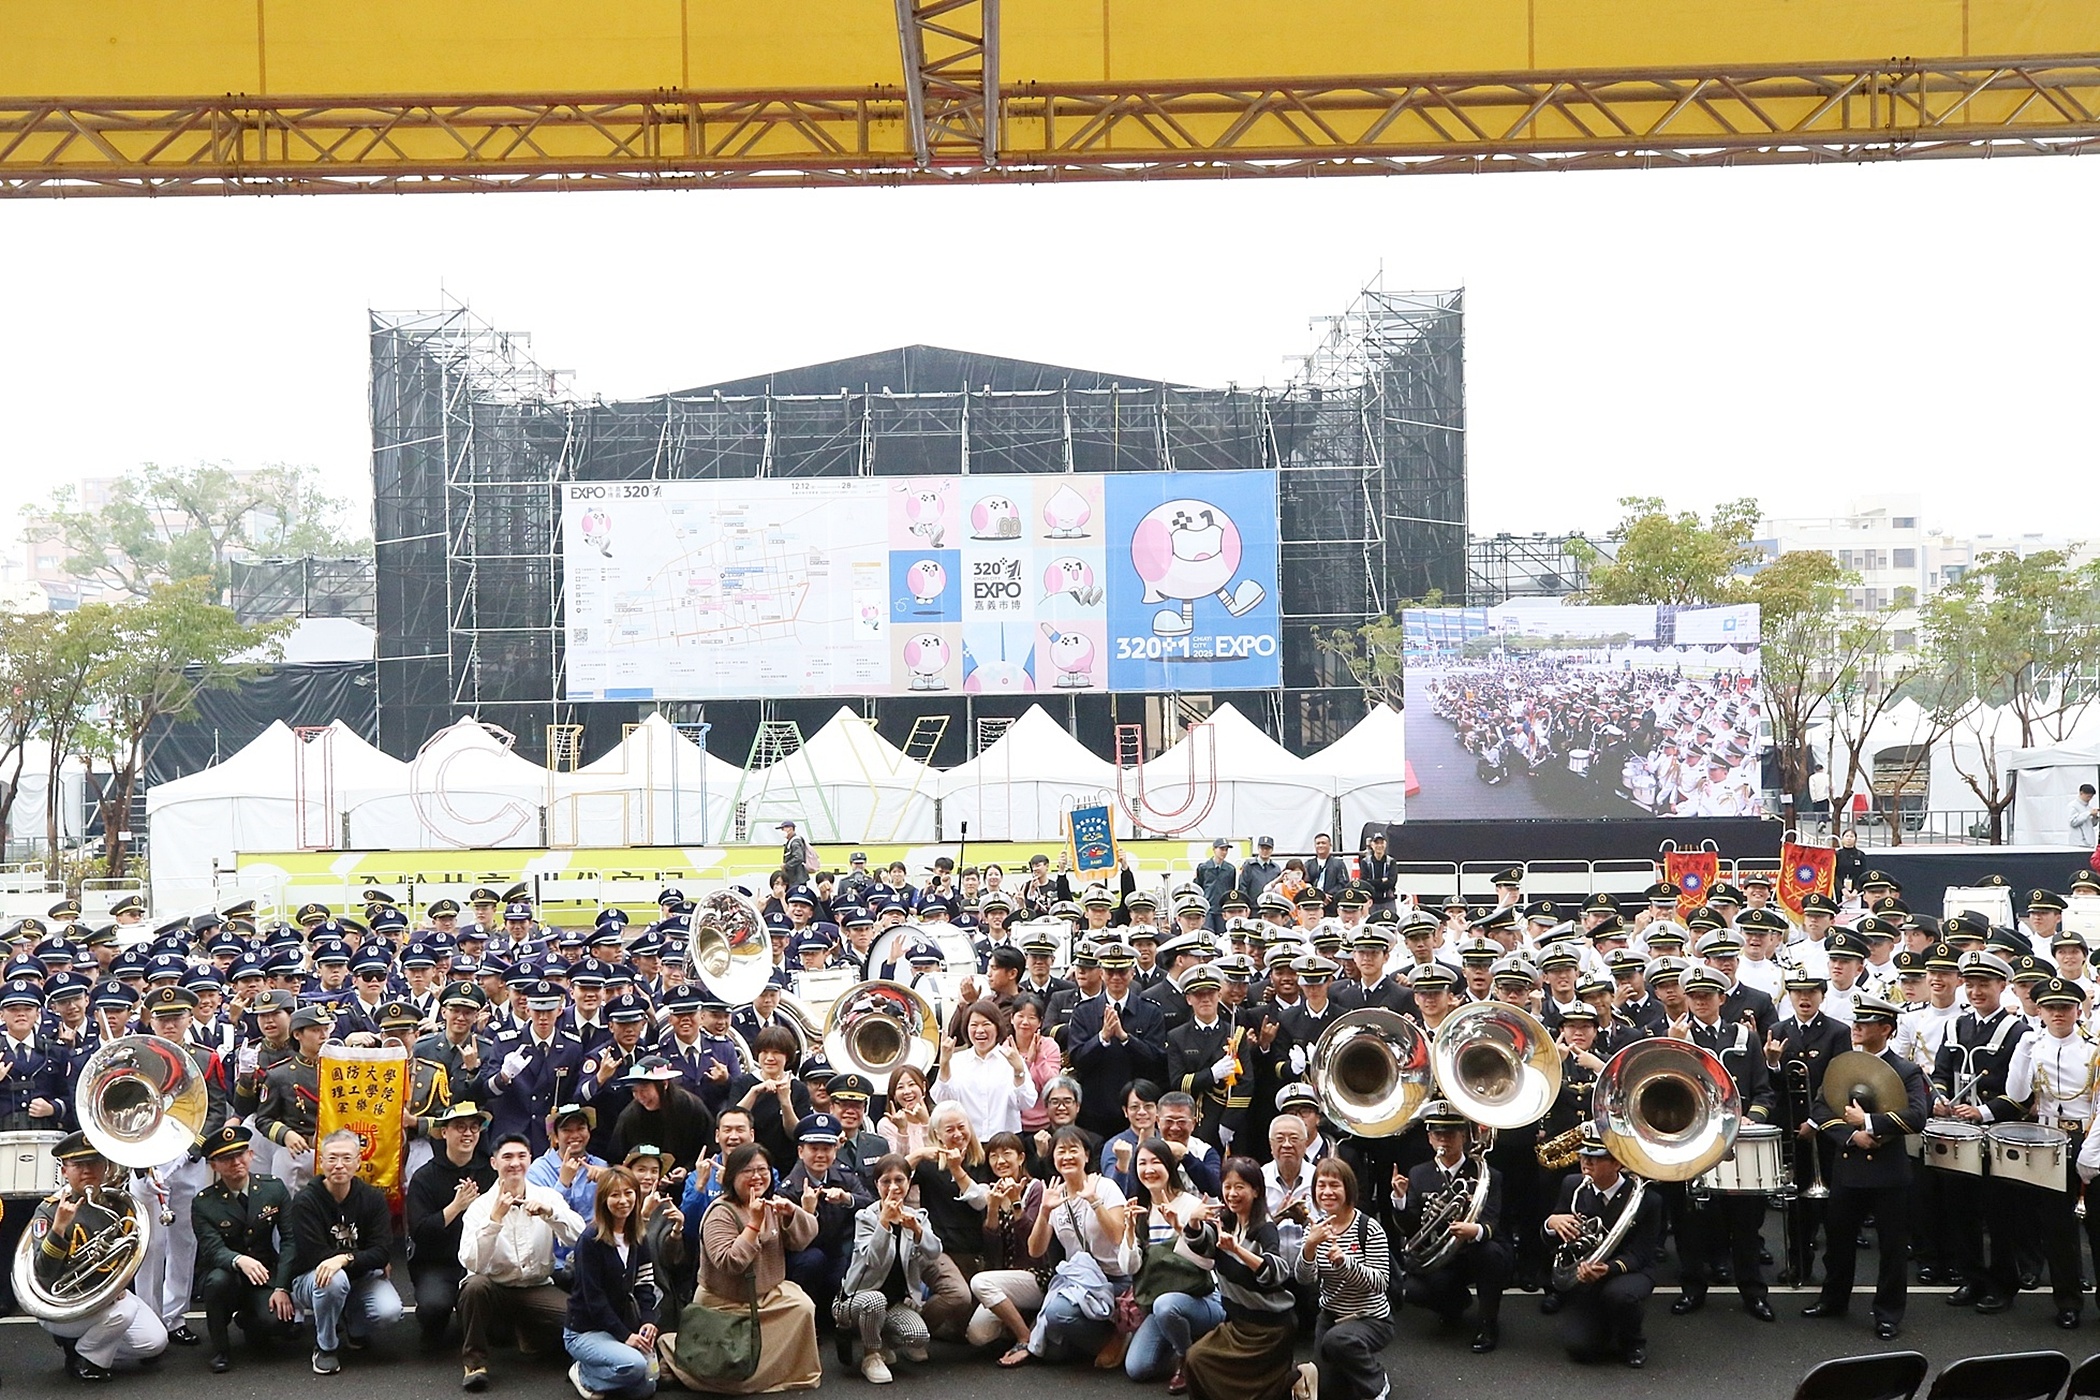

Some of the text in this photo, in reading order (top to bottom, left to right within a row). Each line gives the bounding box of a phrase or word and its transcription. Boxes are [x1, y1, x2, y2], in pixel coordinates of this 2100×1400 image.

[571, 486, 606, 499] EXPO
[974, 582, 1021, 598] EXPO
[974, 600, 1021, 611] 嘉義市博
[1192, 650, 1214, 658] 2025
[1215, 634, 1277, 658] EXPO
[331, 1065, 397, 1084] 國防大學
[331, 1084, 395, 1102] 理工學院
[337, 1099, 385, 1115] 軍樂隊
